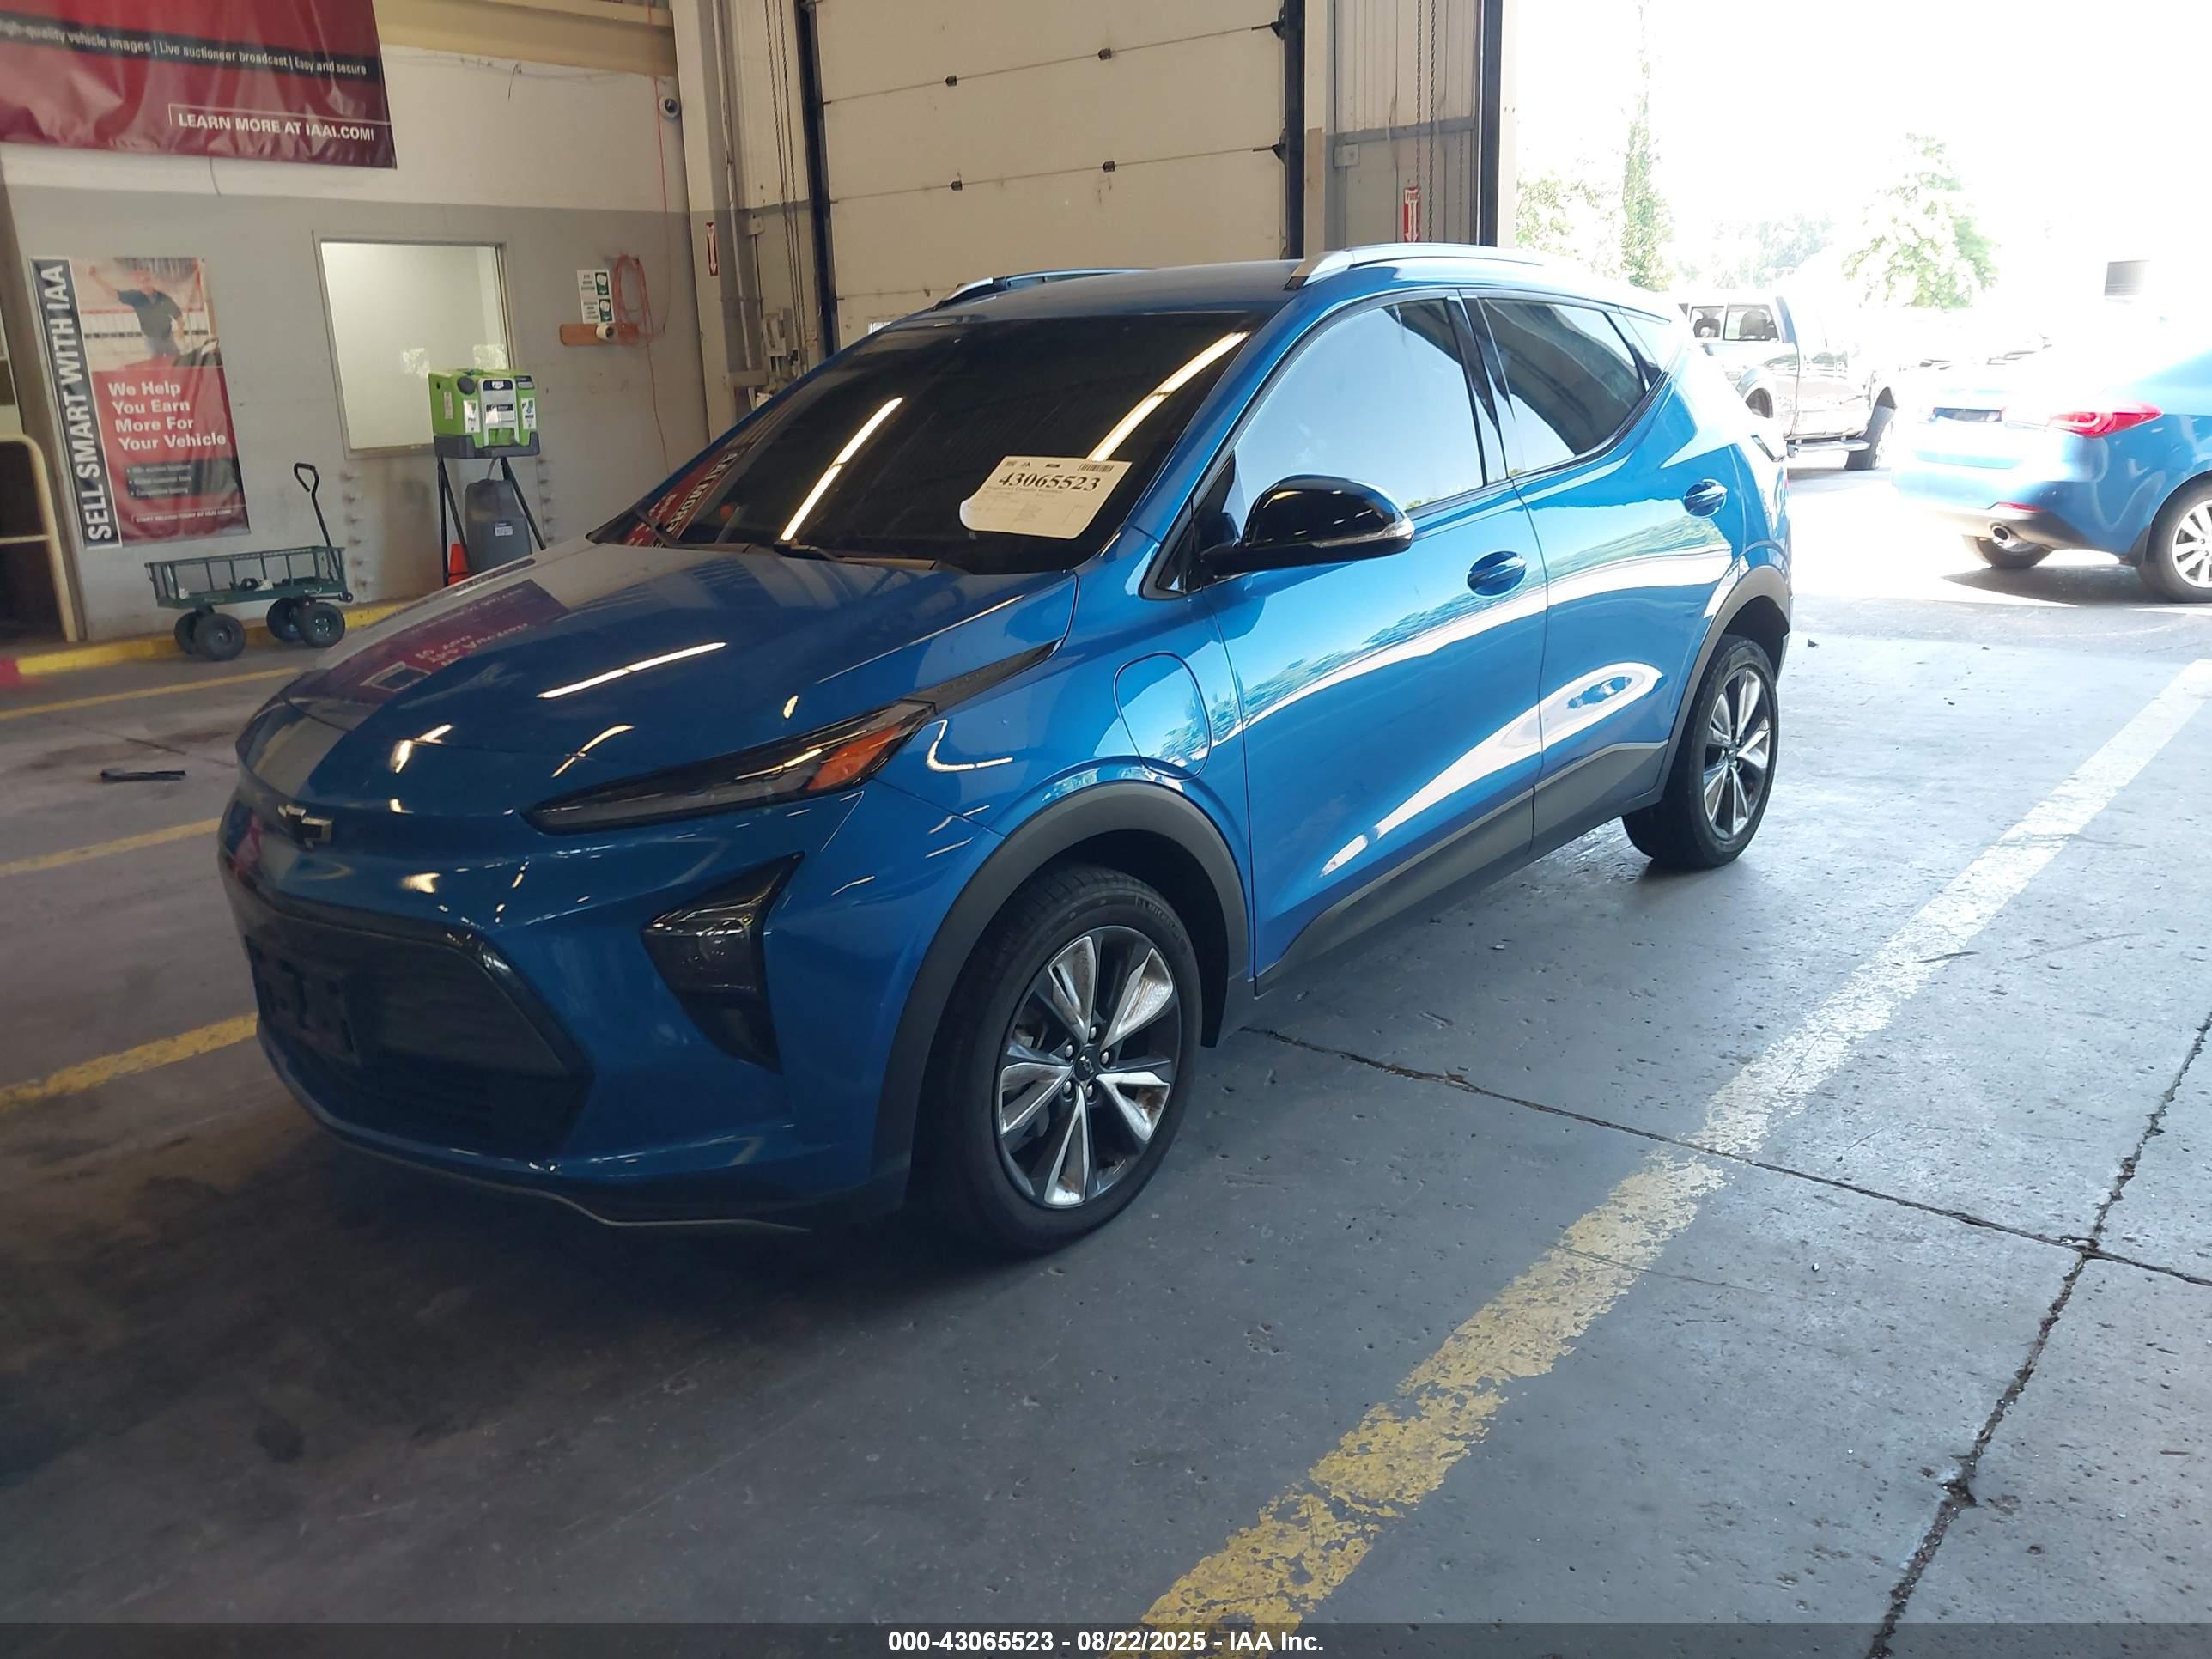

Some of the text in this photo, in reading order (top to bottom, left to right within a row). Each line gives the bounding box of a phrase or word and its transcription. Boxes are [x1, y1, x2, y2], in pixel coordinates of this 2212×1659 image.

[67, 31, 106, 49] vehicle
[109, 36, 151, 53] images
[159, 40, 180, 56] Live
[183, 46, 236, 62] auctioneer
[239, 50, 289, 68] broadcast
[294, 55, 314, 73] Easy
[316, 59, 335, 72] and
[336, 63, 368, 76] secure
[178, 112, 375, 142] LEARN MORE AT IAAI.COM!
[107, 380, 181, 397] We Help
[40, 264, 112, 541] SELL SMART WITH IAA
[112, 398, 191, 416] You Earn
[114, 416, 195, 433] More For
[118, 432, 227, 451] Your Vehicle
[998, 471, 1101, 492] 43065523
